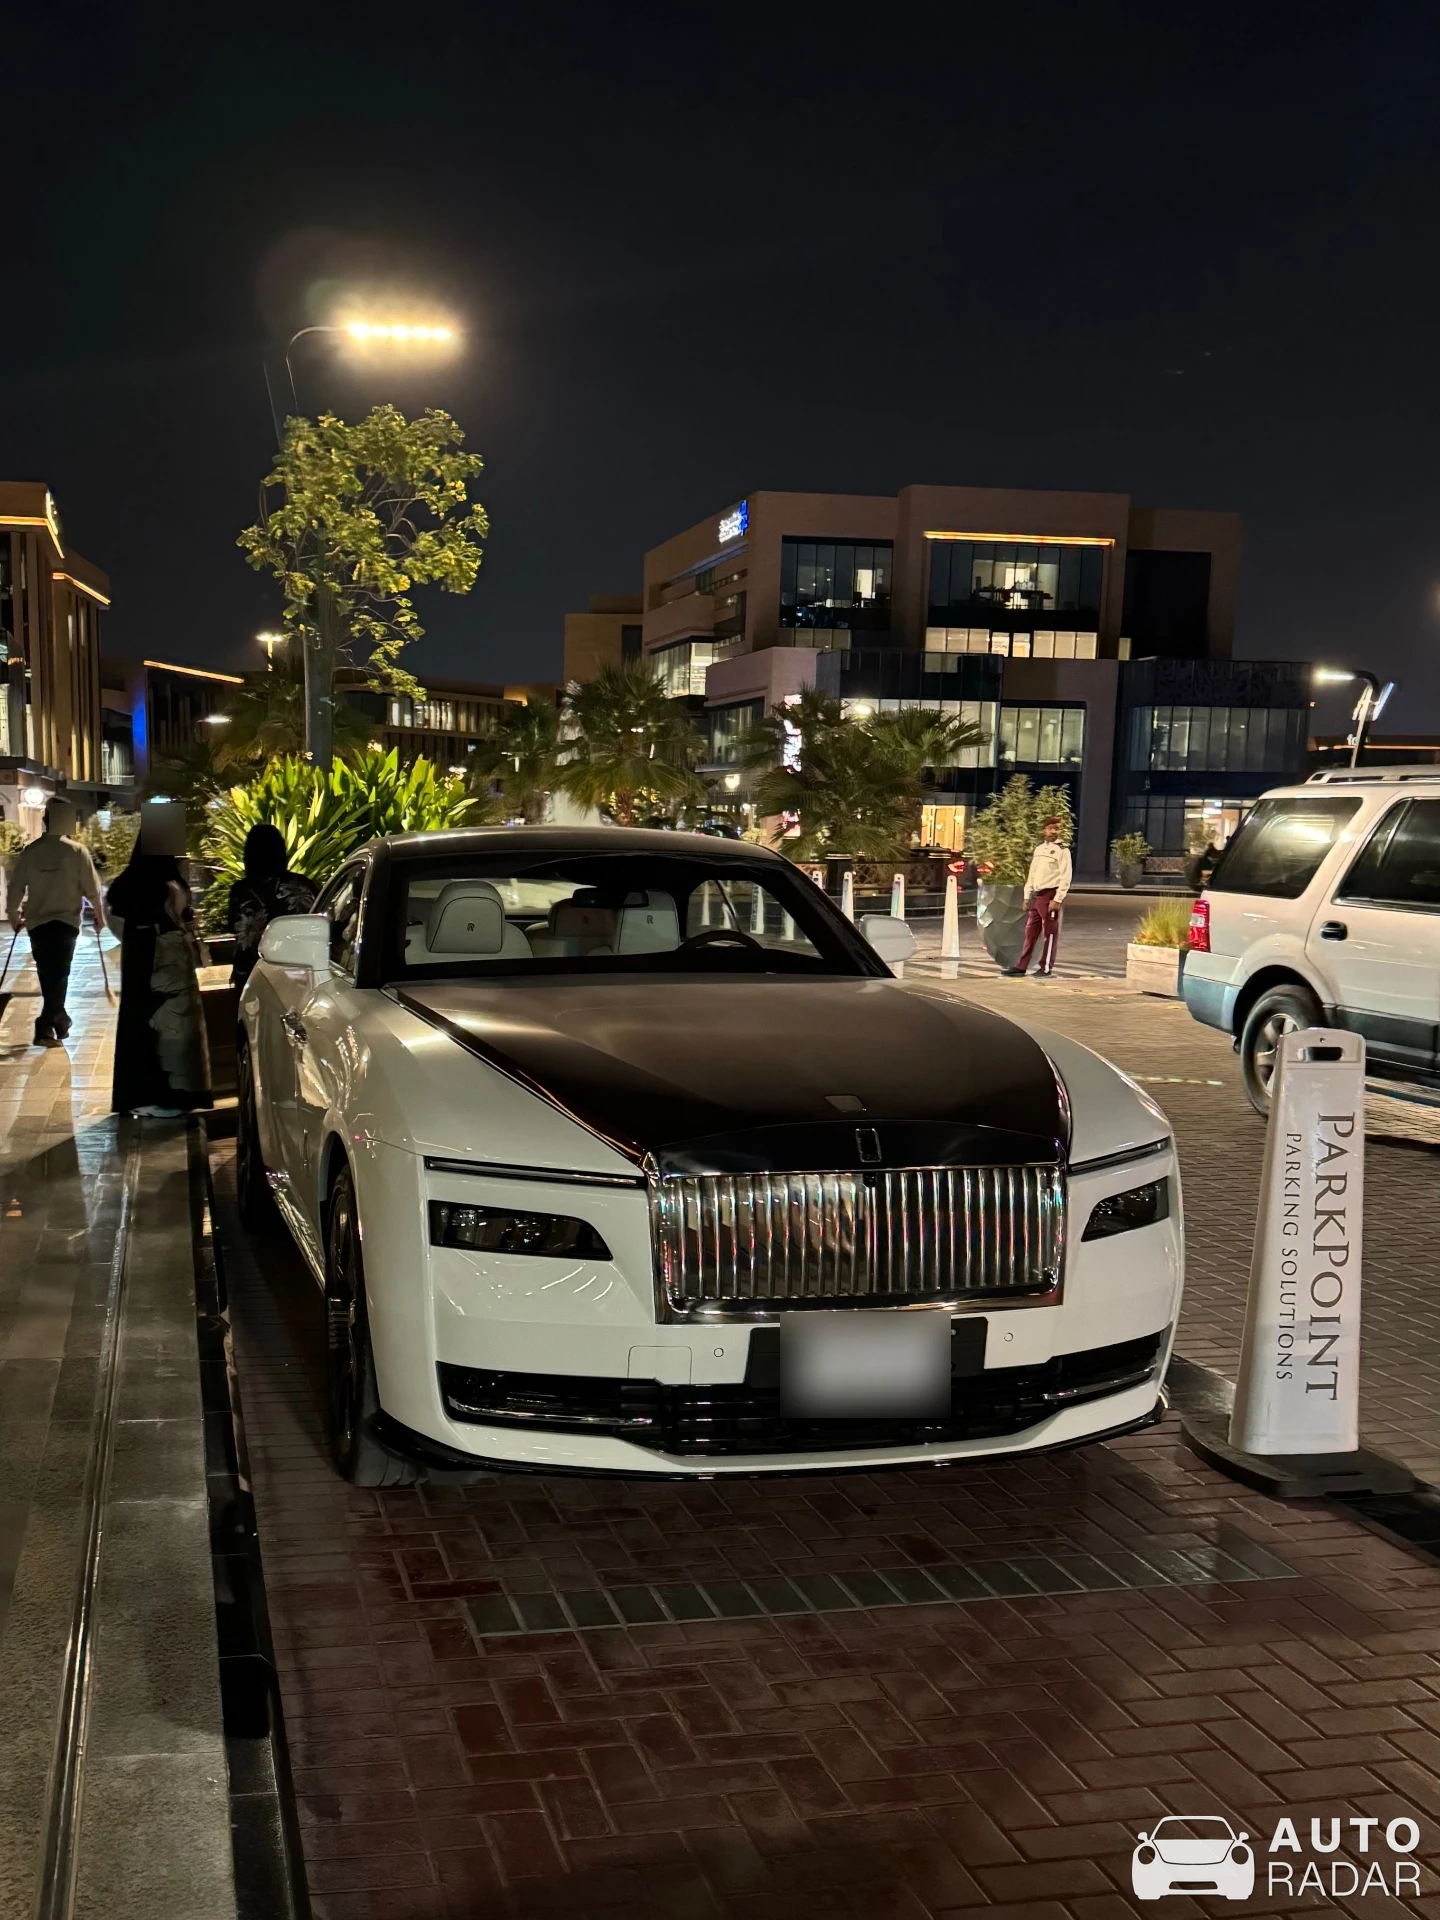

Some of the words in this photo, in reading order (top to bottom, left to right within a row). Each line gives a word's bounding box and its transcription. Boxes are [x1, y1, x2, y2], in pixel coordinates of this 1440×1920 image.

[1282, 1133, 1302, 1236] PARKING
[1276, 1248, 1299, 1380] SOLUTIONS
[1305, 1112, 1355, 1401] PARKPOINT
